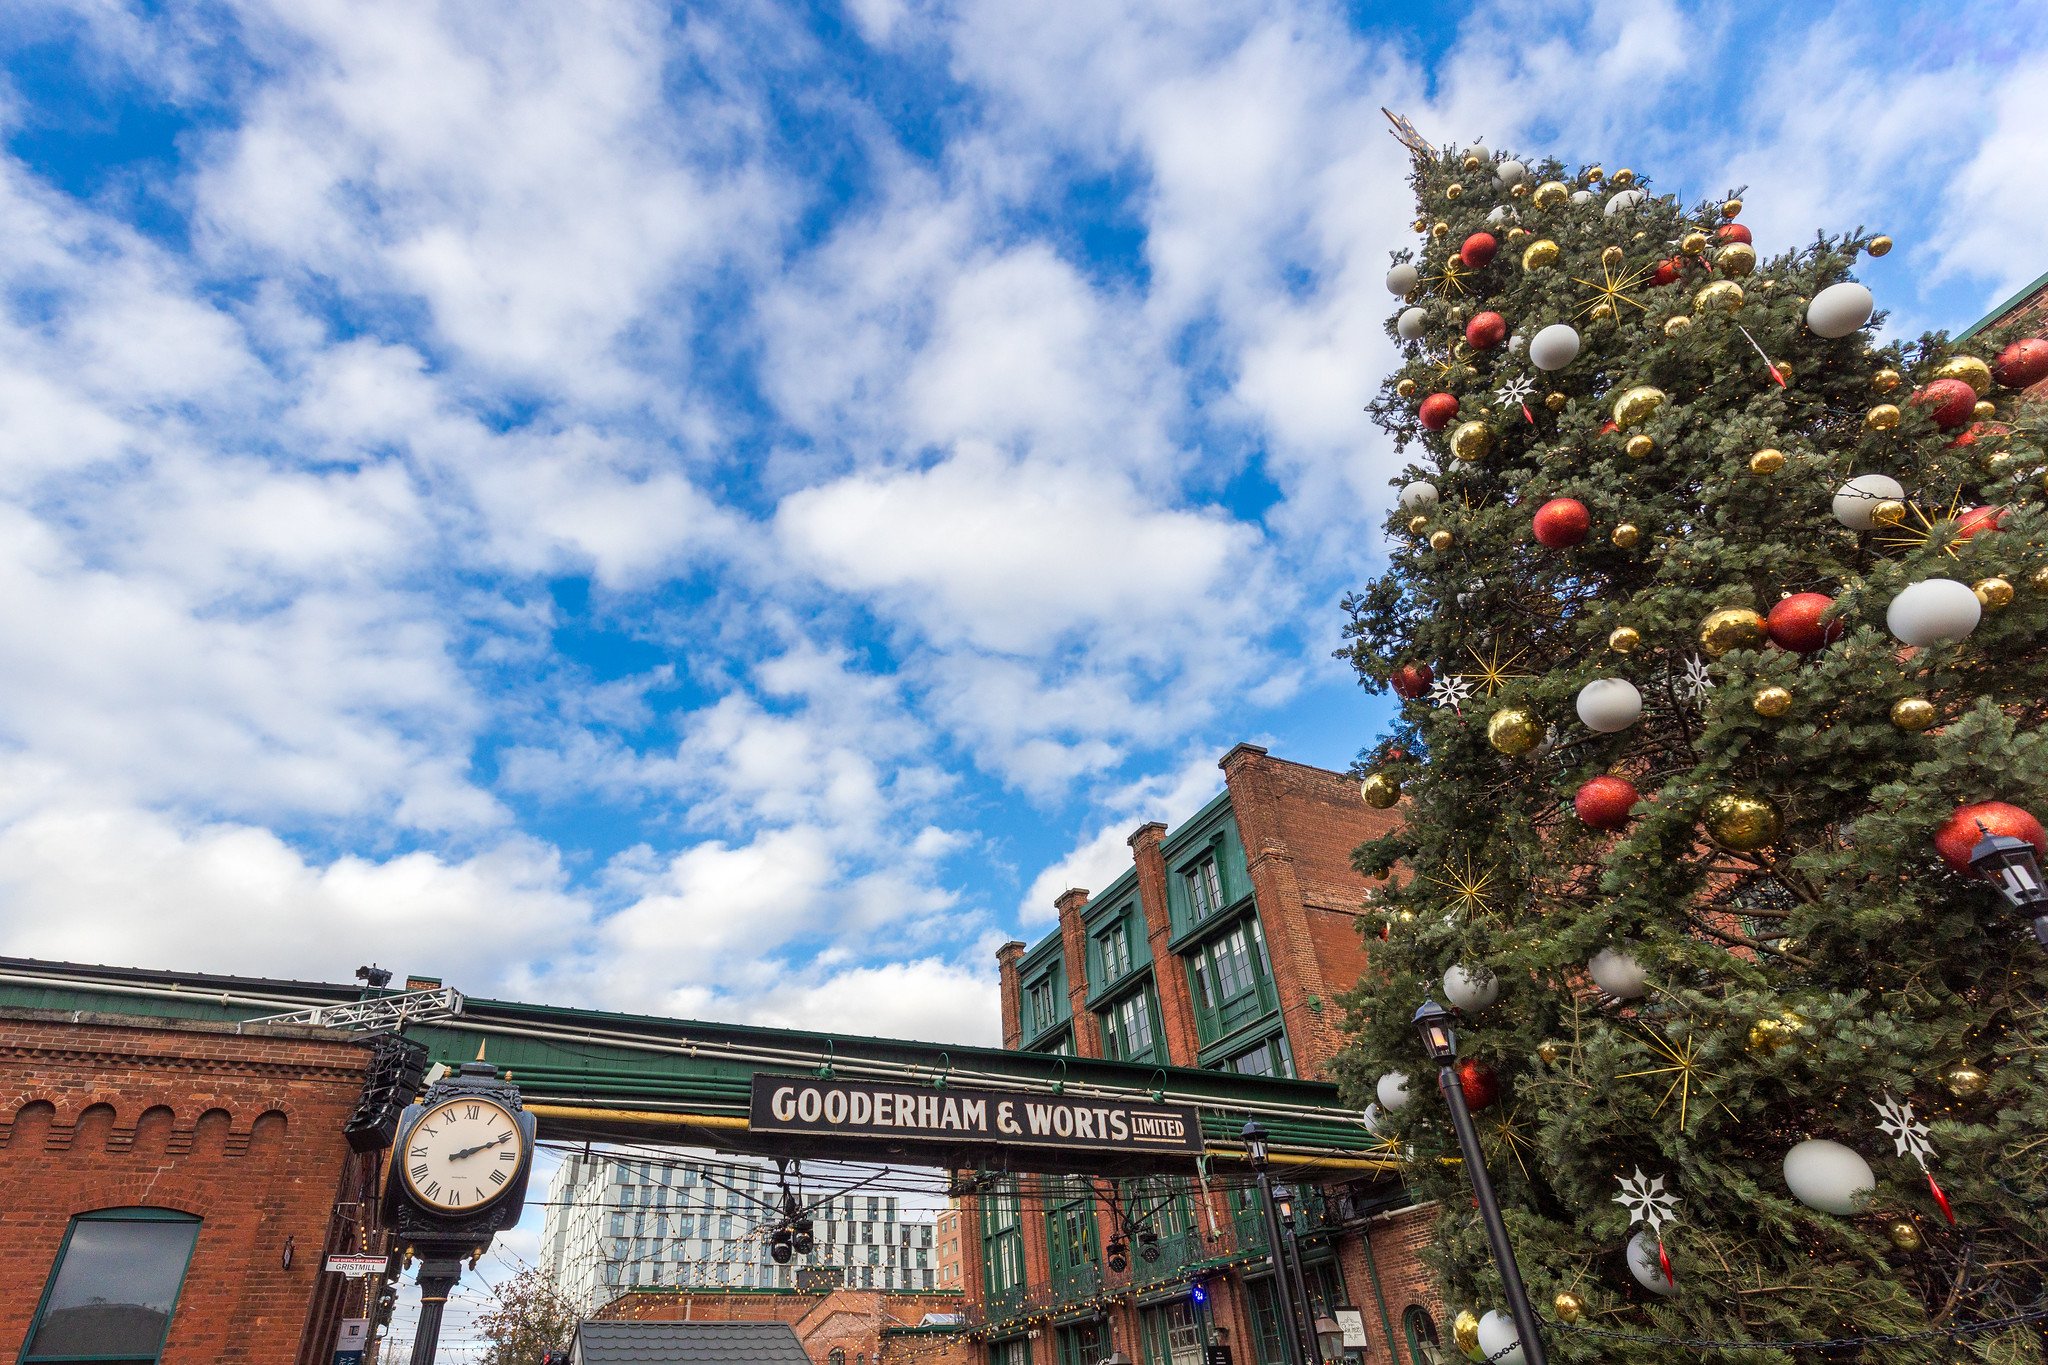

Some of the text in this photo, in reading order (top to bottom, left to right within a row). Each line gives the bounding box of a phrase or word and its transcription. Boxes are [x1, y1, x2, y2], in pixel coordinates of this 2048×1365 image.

[442, 1109, 456, 1125] XI
[464, 1105, 480, 1120] XII
[487, 1113, 498, 1125] I
[772, 1087, 1185, 1140] GOODERHAM & WORTS LIMITED
[422, 1124, 438, 1137] X
[411, 1146, 428, 1157] IX
[500, 1152, 515, 1160] III
[411, 1163, 428, 1184] VIII
[424, 1181, 441, 1201] VII
[448, 1190, 460, 1205] VI
[476, 1187, 485, 1201] V
[336, 1263, 376, 1271] GRISTMILL
